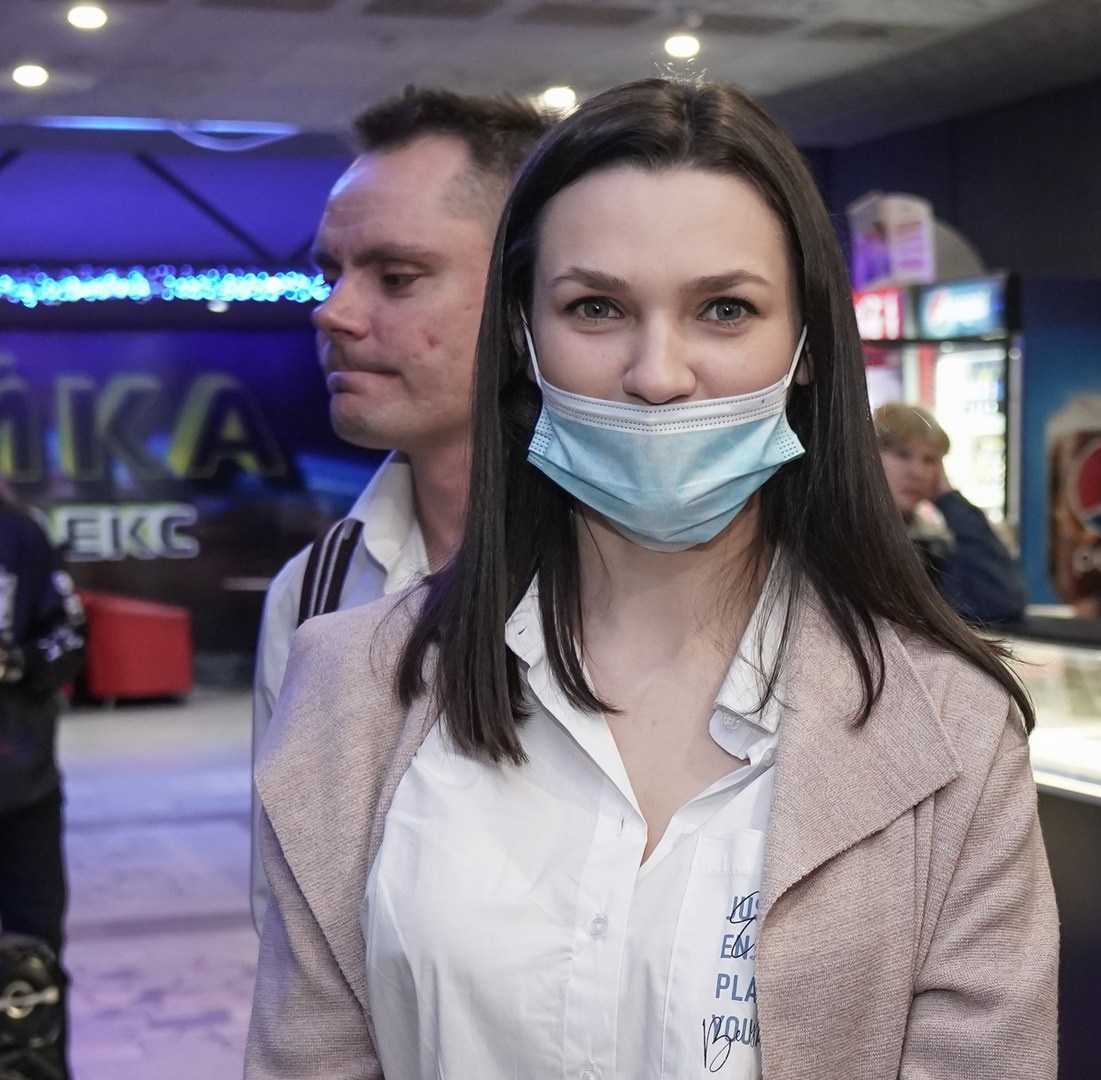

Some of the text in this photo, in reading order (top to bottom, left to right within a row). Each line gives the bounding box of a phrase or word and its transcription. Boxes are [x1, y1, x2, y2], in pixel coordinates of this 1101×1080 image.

[28, 502, 200, 563] ЕКС
[726, 896, 759, 921] JU
[720, 934, 756, 960] EN
